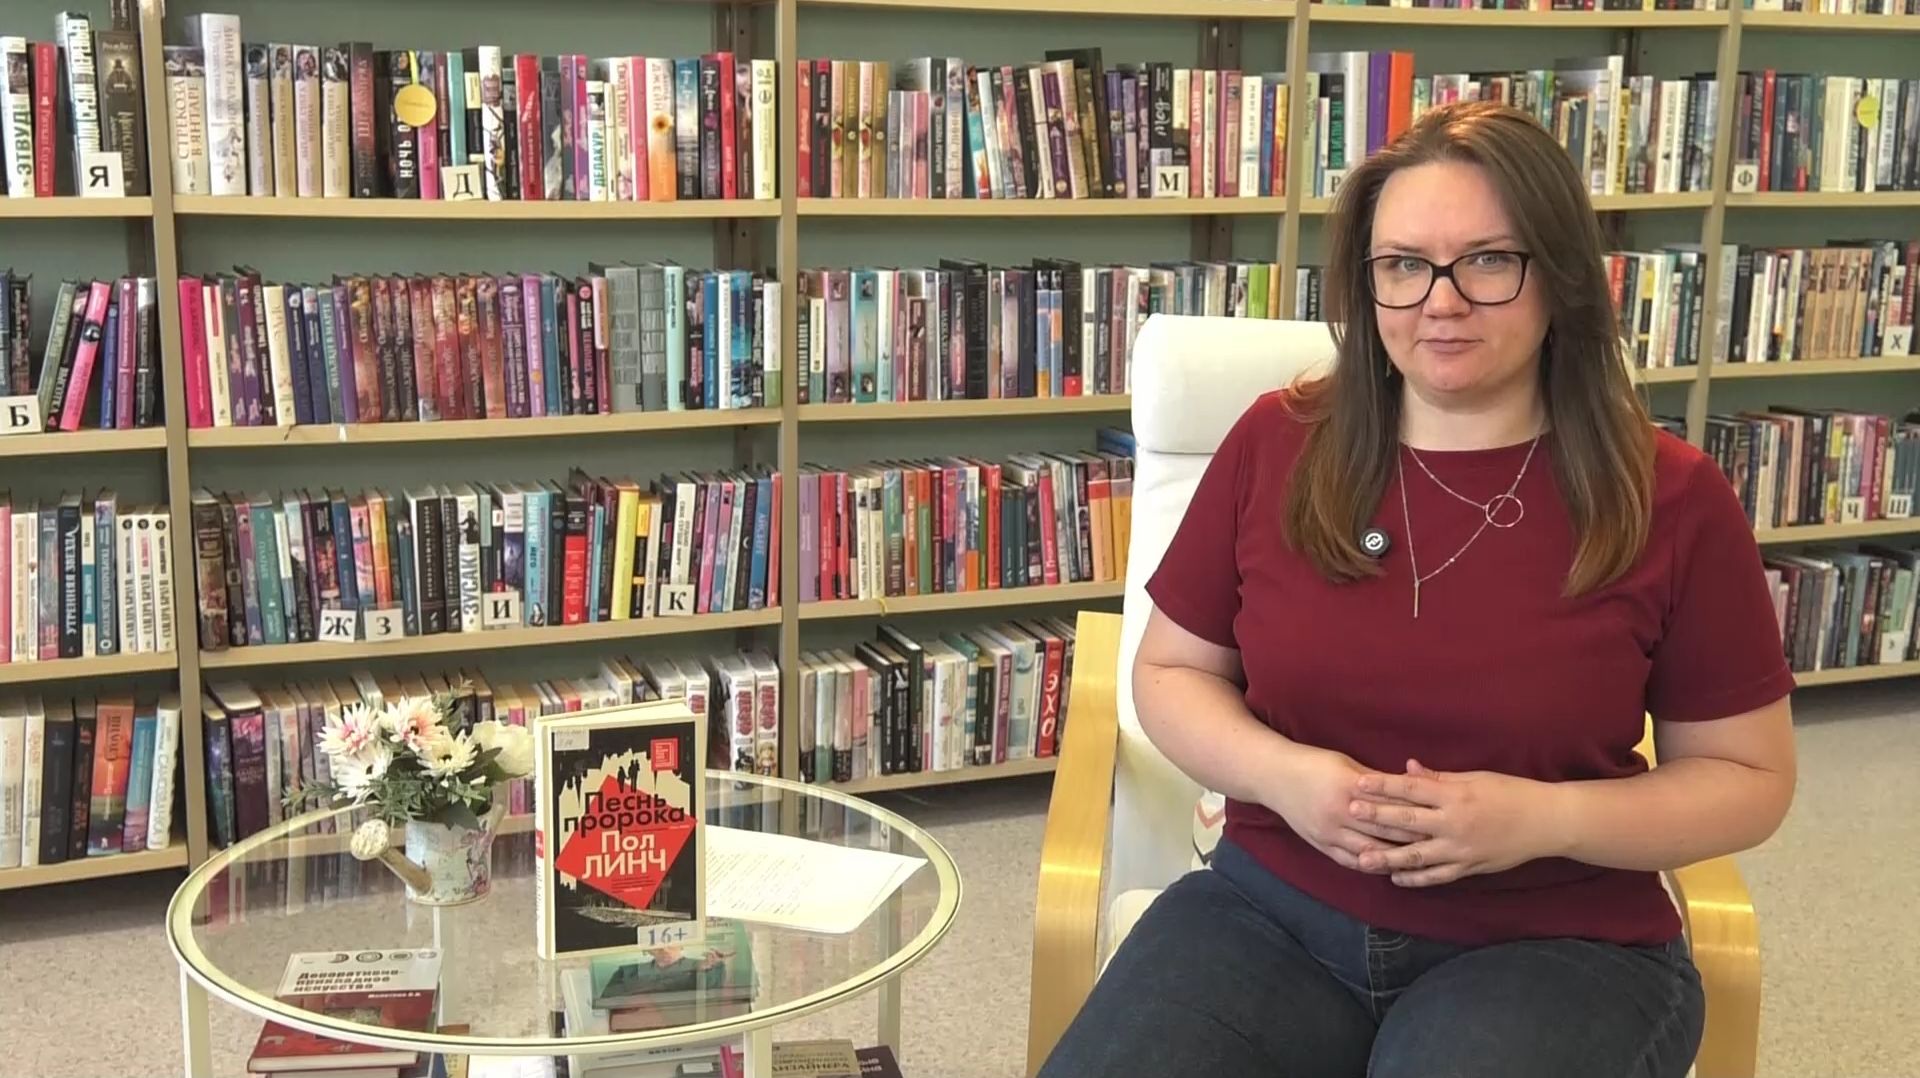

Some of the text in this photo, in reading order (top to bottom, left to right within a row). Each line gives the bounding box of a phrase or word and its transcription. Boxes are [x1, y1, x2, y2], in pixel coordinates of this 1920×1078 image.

[176, 79, 190, 160] СТРЕКОЗА
[188, 85, 202, 144] ЯНТАРЕ
[13, 110, 32, 176] ЭТВУД
[398, 139, 414, 178] НОЧЬ
[592, 131, 606, 188] ДЕЛАКУР
[89, 165, 109, 188] Я
[452, 173, 474, 199] Д
[1159, 172, 1183, 192] М
[1737, 169, 1753, 187] Ф
[10, 405, 31, 427] Б
[1889, 499, 1908, 515] Ш
[64, 523, 80, 636] УТРЕННЯЯ ЗВЕЗДА
[460, 557, 479, 615] ЗУСАК
[492, 599, 511, 619] И
[668, 591, 686, 611] К
[323, 616, 353, 637] Ж
[375, 616, 392, 636] З
[1041, 672, 1059, 738] ЭХО
[584, 791, 667, 815] Песнь
[563, 807, 685, 839] пророка
[601, 829, 656, 854] Пол
[581, 848, 667, 880] ЛИНЧ
[648, 926, 689, 948] 16+
